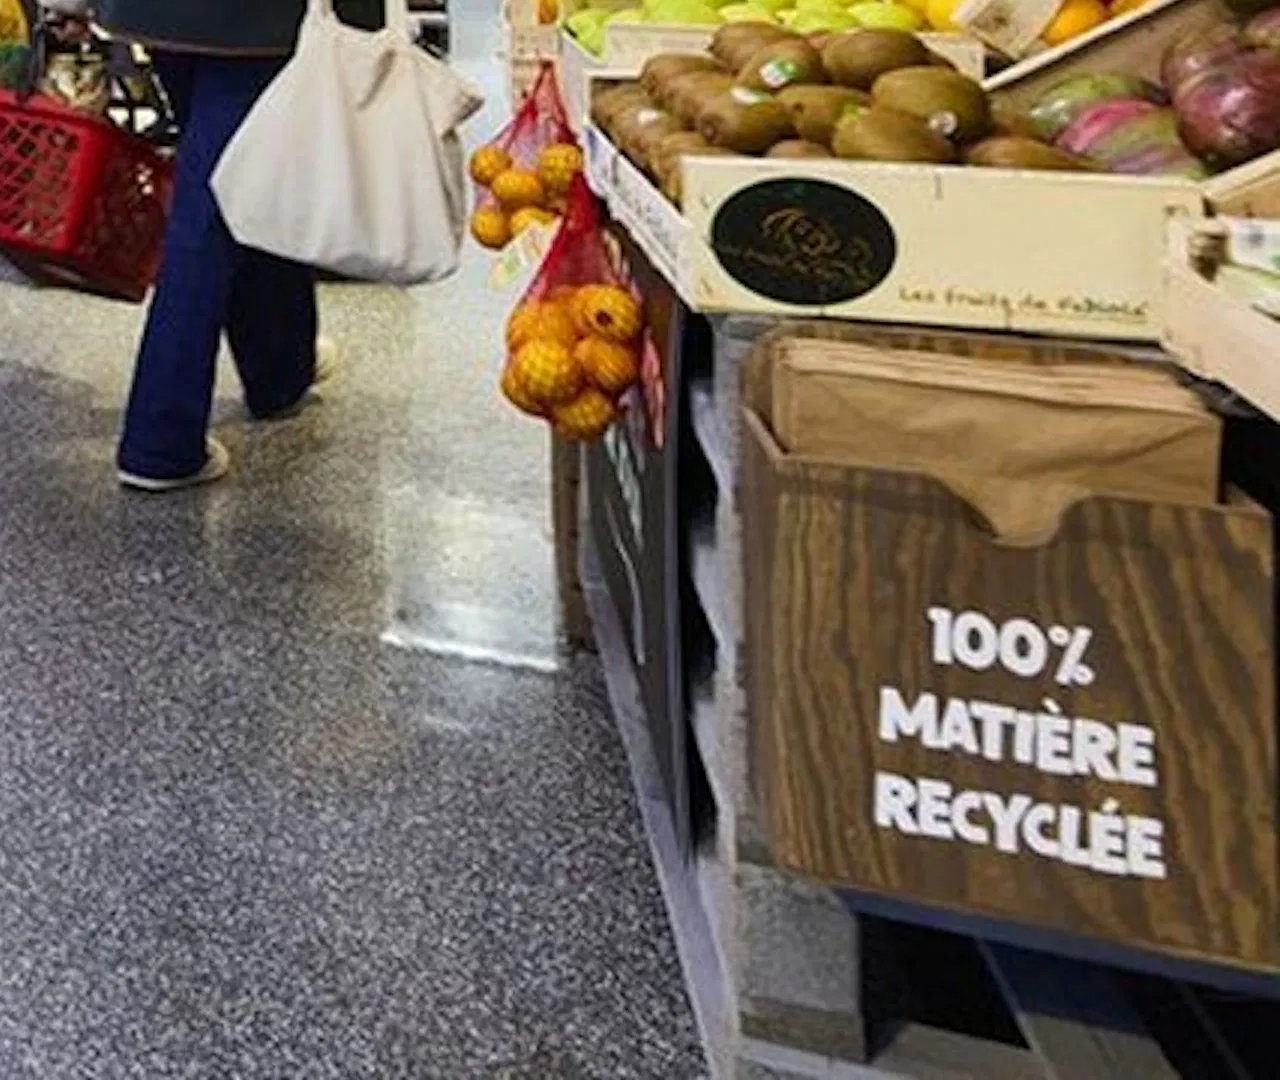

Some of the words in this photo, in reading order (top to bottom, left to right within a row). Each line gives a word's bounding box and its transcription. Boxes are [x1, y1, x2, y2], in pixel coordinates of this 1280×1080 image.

[926, 605, 1097, 687] 100%
[878, 685, 1159, 788] MATIÈRE
[873, 771, 1169, 880] RECYCLÉE
